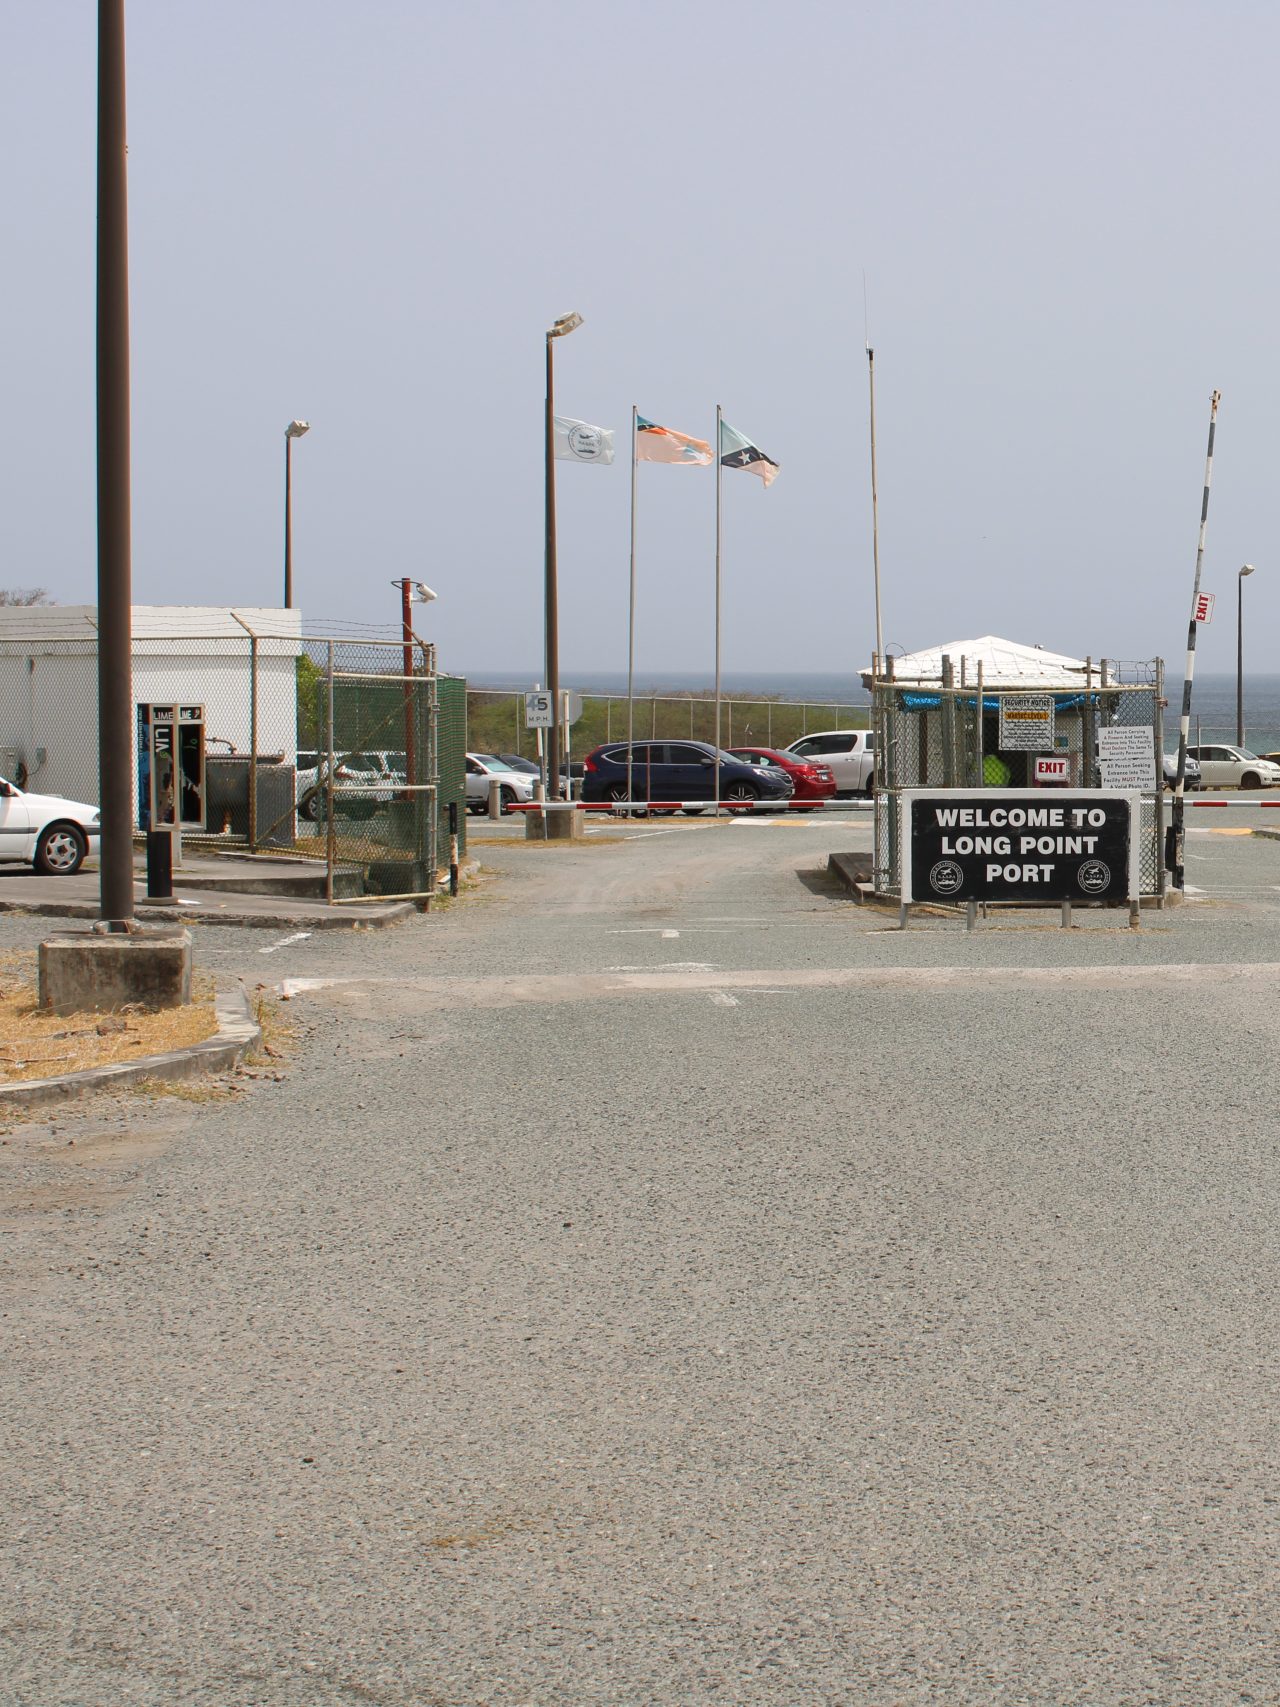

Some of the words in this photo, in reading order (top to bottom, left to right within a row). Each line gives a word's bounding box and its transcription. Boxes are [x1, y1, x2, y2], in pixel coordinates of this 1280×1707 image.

[1195, 594, 1209, 621] EXIT
[153, 711, 174, 720] LIME
[1038, 762, 1065, 773] EXIT
[936, 808, 1064, 827] WELCOME
[1072, 808, 1106, 827] TO
[941, 836, 1011, 855] LONG
[1020, 836, 1099, 855] POINT
[986, 864, 1055, 883] PORT
